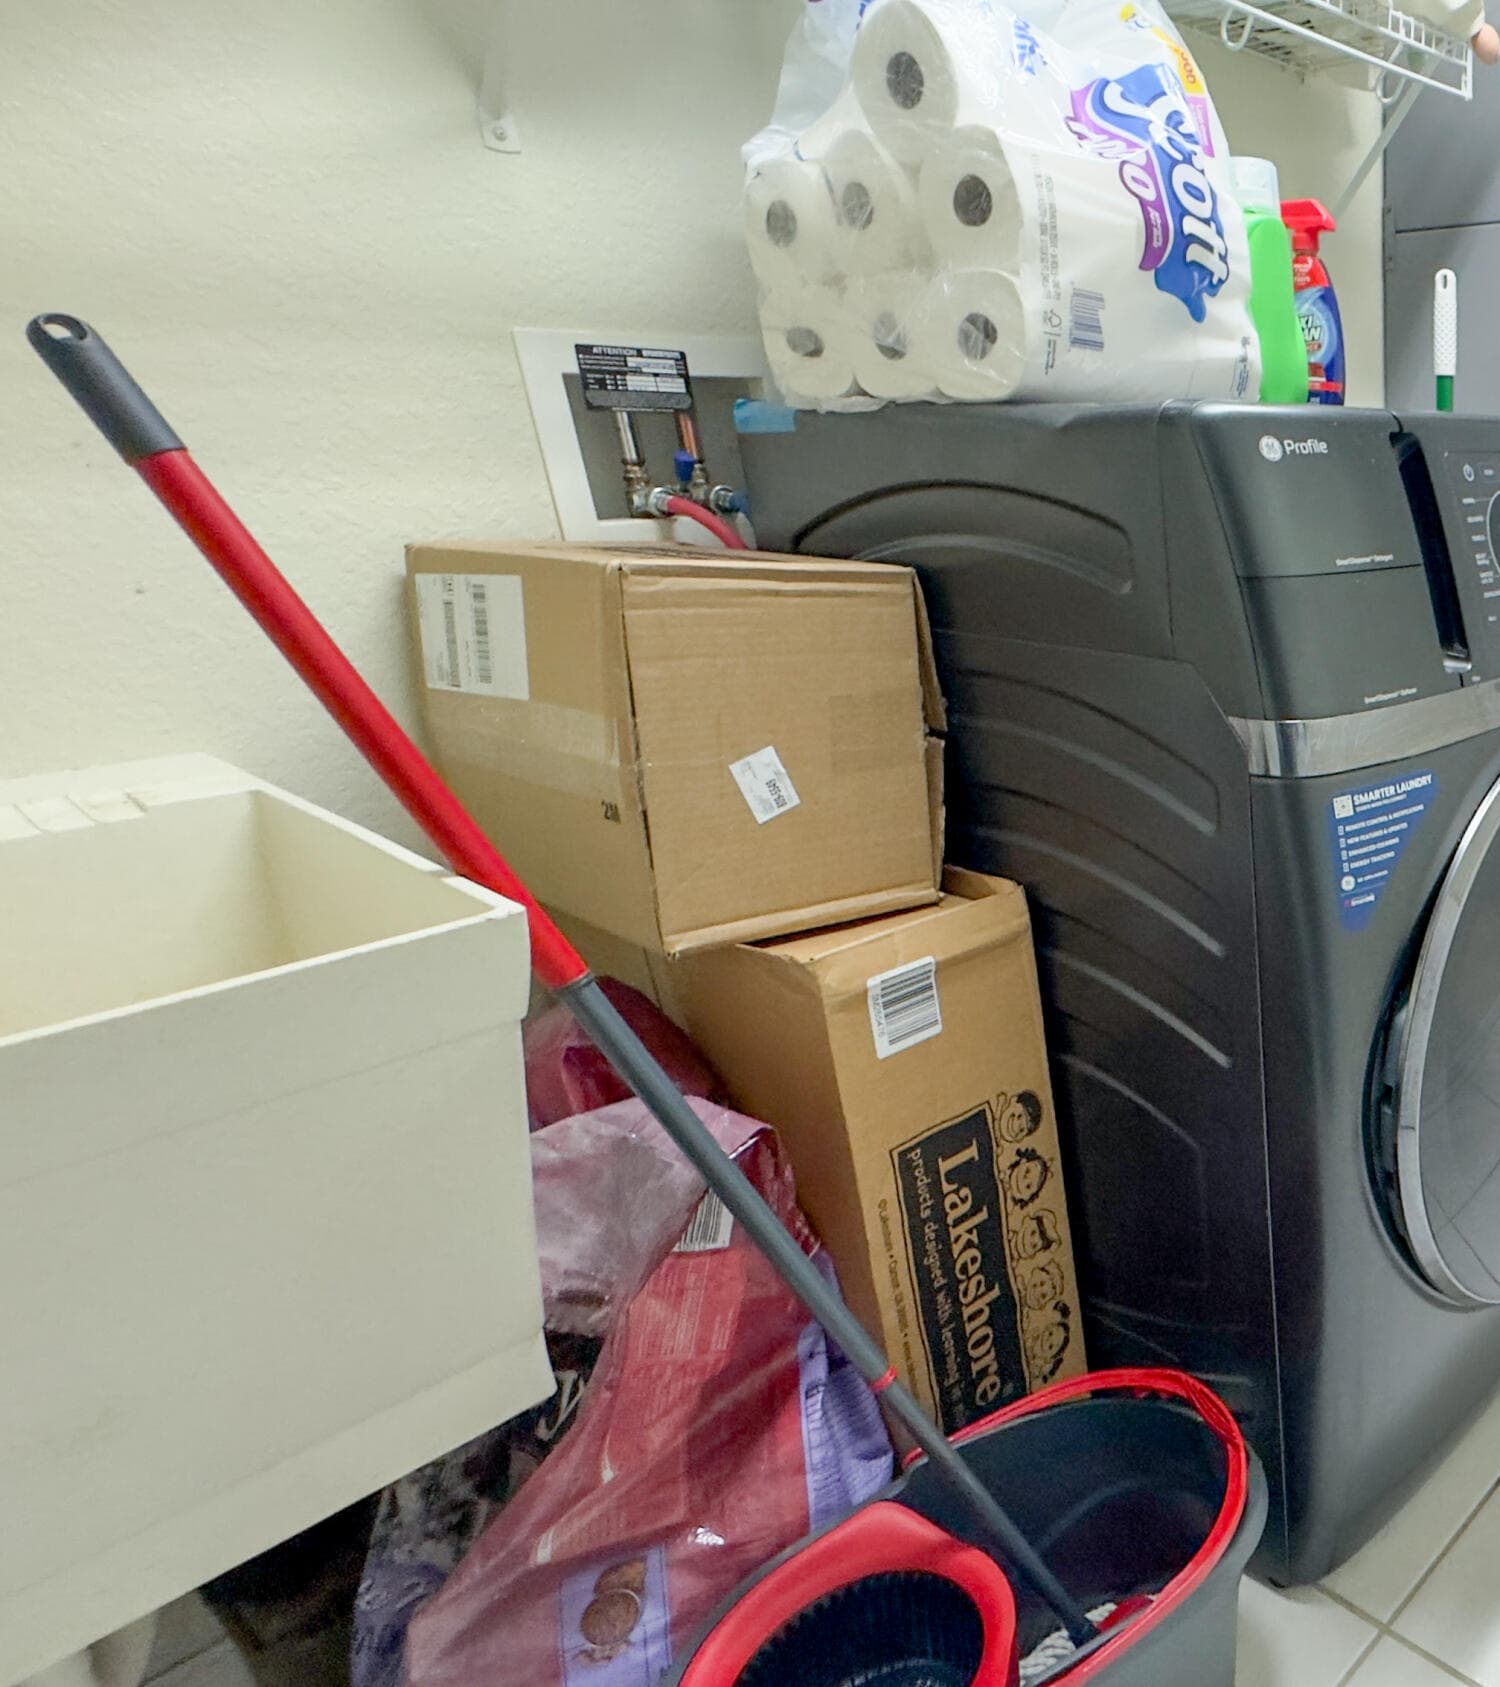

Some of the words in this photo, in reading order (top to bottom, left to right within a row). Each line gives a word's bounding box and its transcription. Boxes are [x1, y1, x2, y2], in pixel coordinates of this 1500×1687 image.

[1104, 80, 1229, 286] Scott
[592, 347, 637, 356] ATTENTION
[1283, 439, 1328, 455] Profile
[1353, 785, 1396, 805] SMARTER
[1396, 773, 1432, 793] LAUNDRY
[904, 1148, 934, 1219] products
[923, 1221, 948, 1289] designed
[938, 1138, 1000, 1406] Lakeshore
[935, 1289, 953, 1325] with
[941, 1322, 961, 1389] learning
